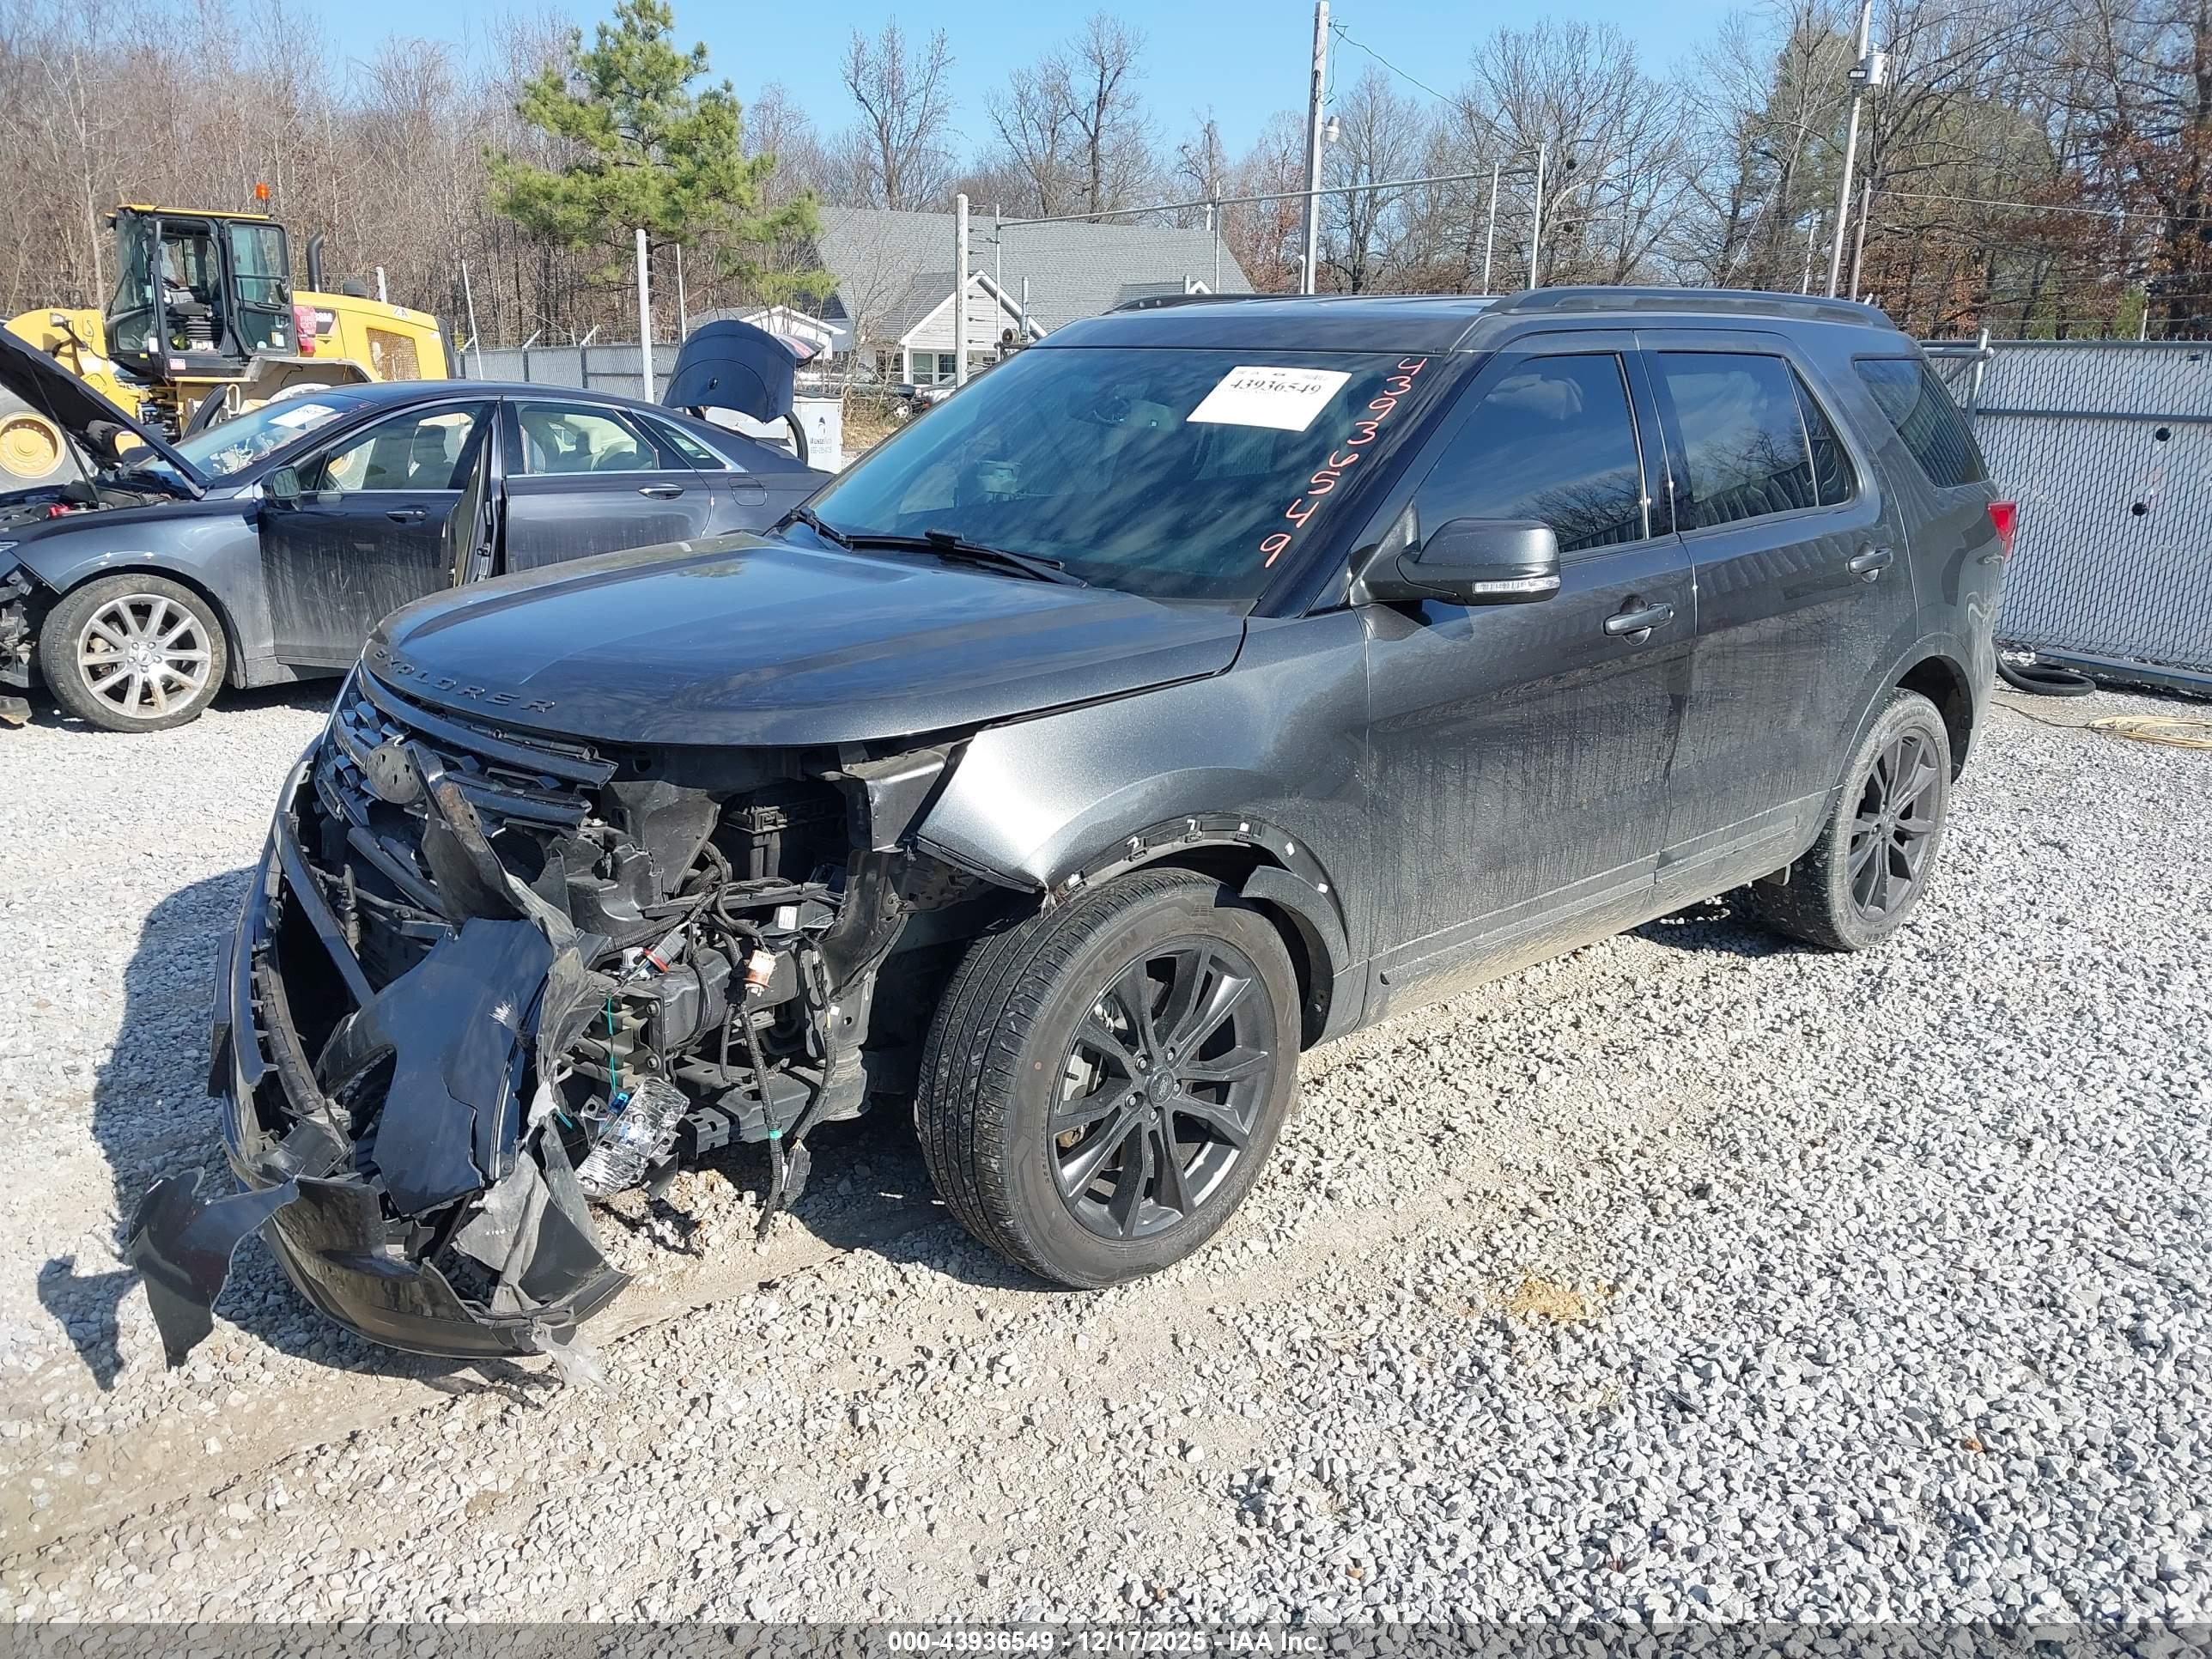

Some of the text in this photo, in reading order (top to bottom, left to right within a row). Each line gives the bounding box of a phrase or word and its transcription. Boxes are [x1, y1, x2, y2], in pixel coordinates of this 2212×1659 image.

[1230, 378, 1322, 395] 43936549
[1259, 357, 1428, 568] 43936549
[374, 649, 556, 714] EXPLORER
